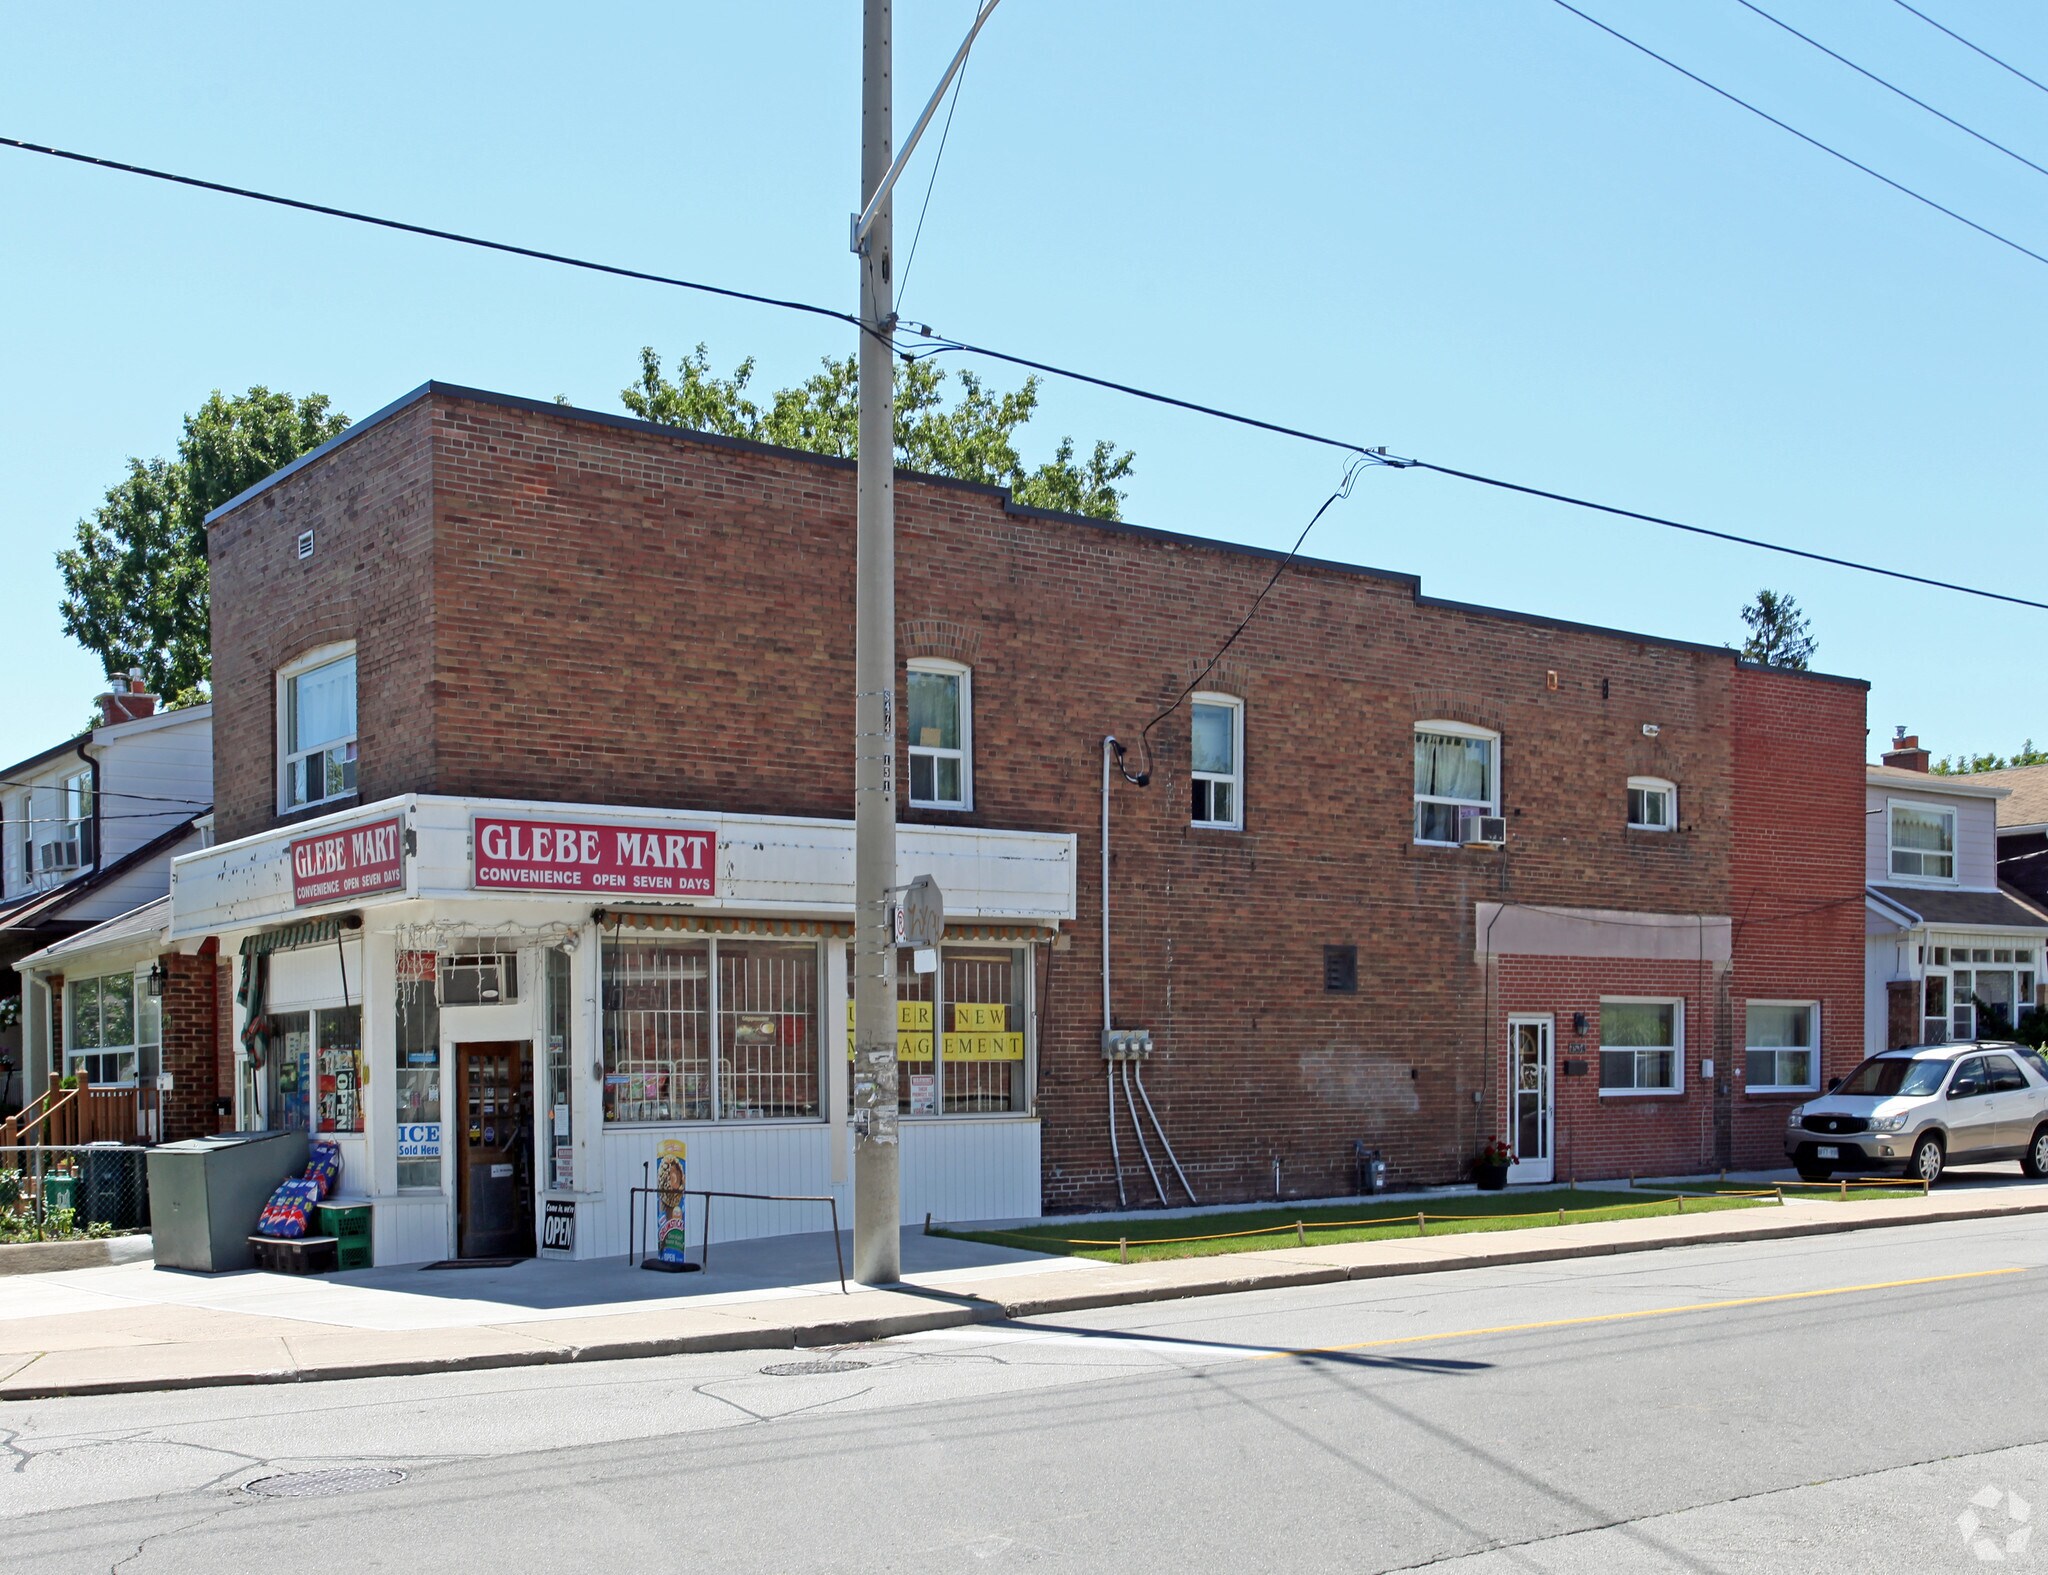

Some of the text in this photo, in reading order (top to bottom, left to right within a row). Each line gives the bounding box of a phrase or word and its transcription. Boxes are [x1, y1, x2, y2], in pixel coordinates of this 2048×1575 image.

[295, 825, 398, 878] GLEBE MART
[481, 824, 708, 869] GLEBE MART
[297, 869, 401, 899] CONVENIENCE OPEN SEVEN DAYS
[479, 867, 710, 890] CONVENIENCE OPEN SEVEN DAYS
[611, 987, 660, 1009] OPEN
[958, 1010, 1004, 1024] NEW
[336, 1073, 348, 1130] OPEN
[398, 1125, 440, 1142] ICE
[399, 1145, 439, 1156] Sold Here
[545, 1215, 573, 1246] OPEN
[663, 1253, 676, 1262] OPEN
